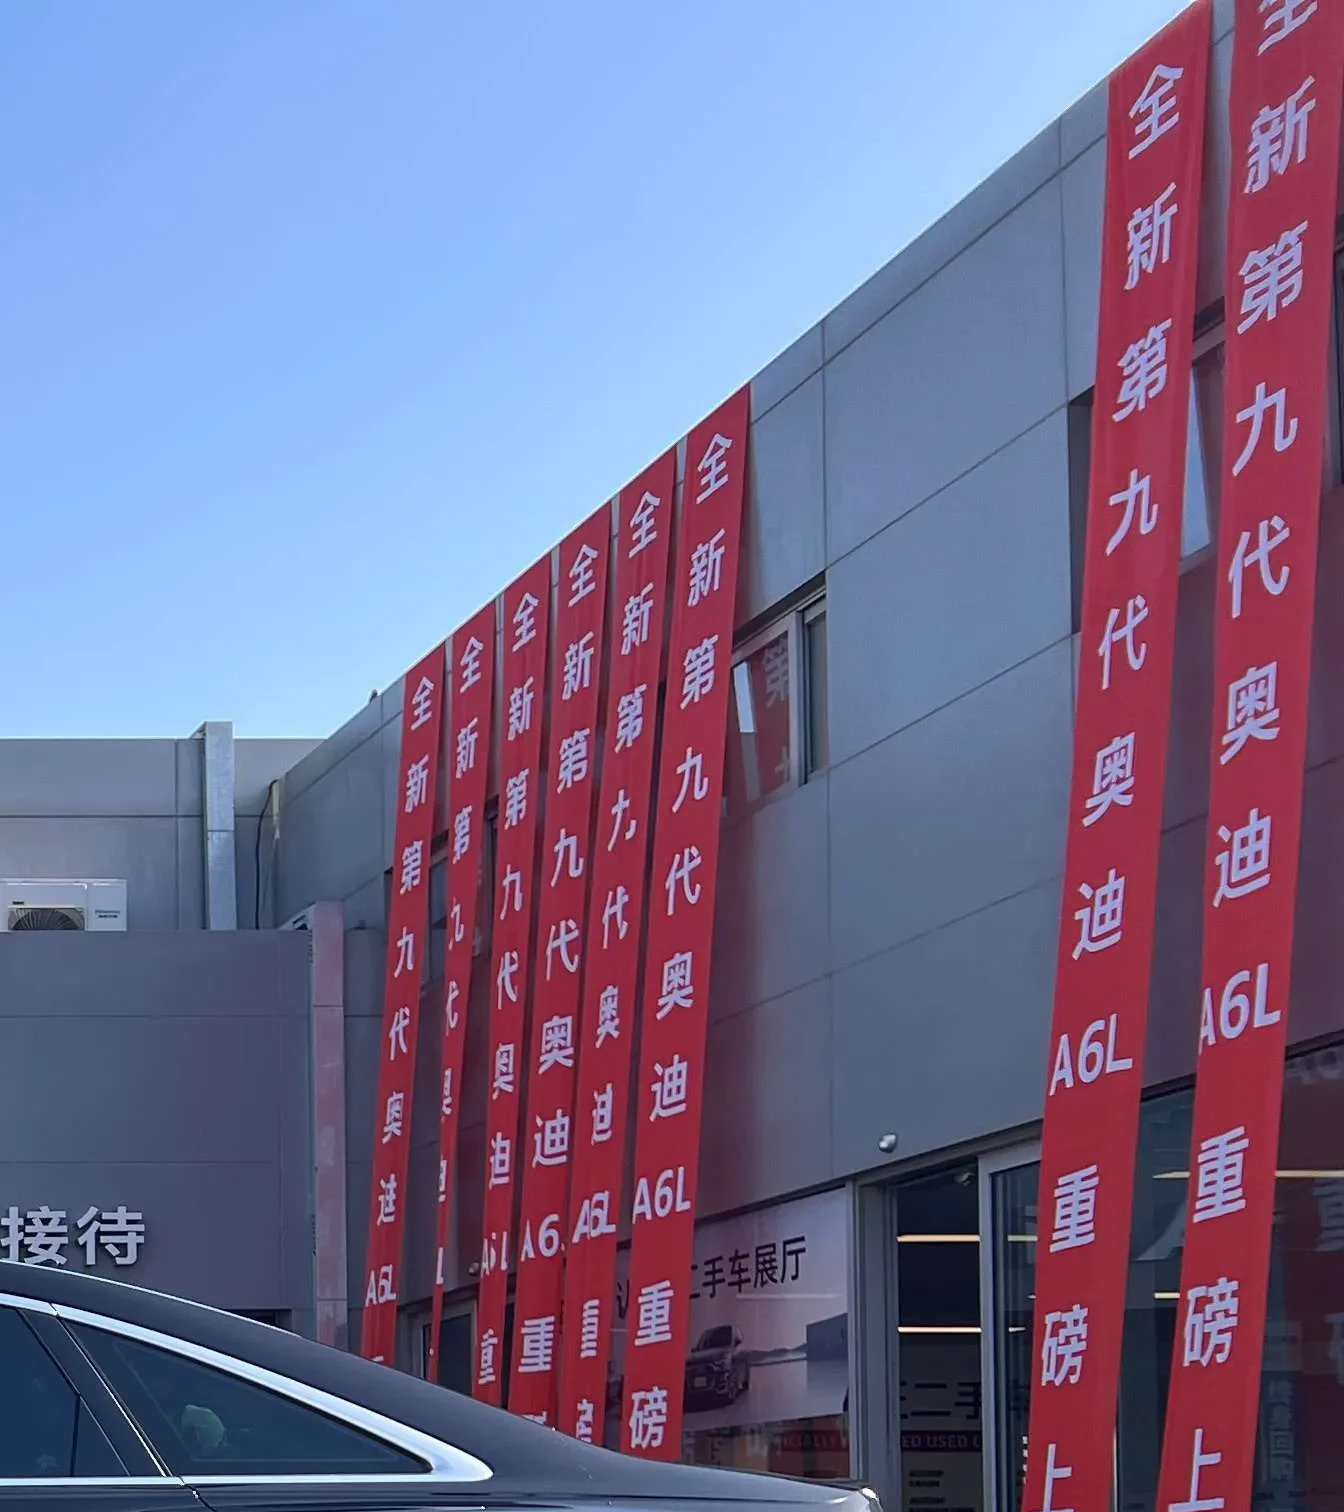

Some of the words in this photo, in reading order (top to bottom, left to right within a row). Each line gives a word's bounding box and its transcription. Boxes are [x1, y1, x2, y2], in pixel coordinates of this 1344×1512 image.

[365, 677, 435, 1361] 全新第九代奥迪A6L
[629, 432, 732, 1449] 全新第九代奥迪A6L重磅
